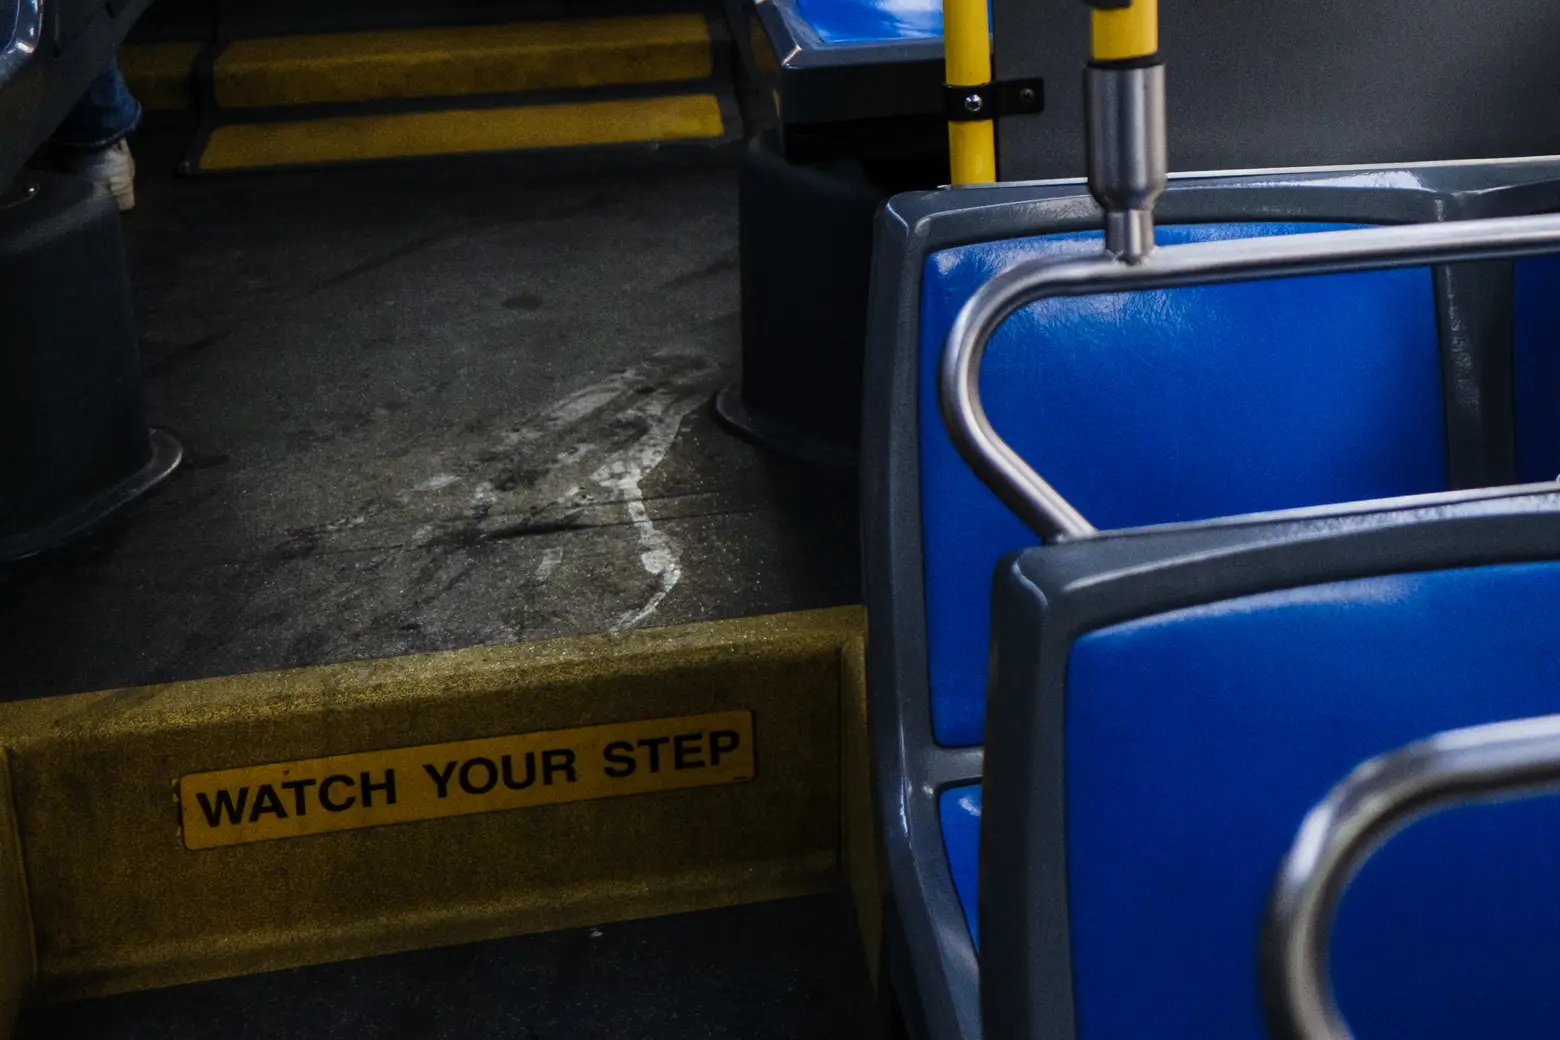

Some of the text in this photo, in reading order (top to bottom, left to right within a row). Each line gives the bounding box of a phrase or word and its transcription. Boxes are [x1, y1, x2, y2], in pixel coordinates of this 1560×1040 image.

[197, 729, 740, 828] WATCH YOUR STEP
